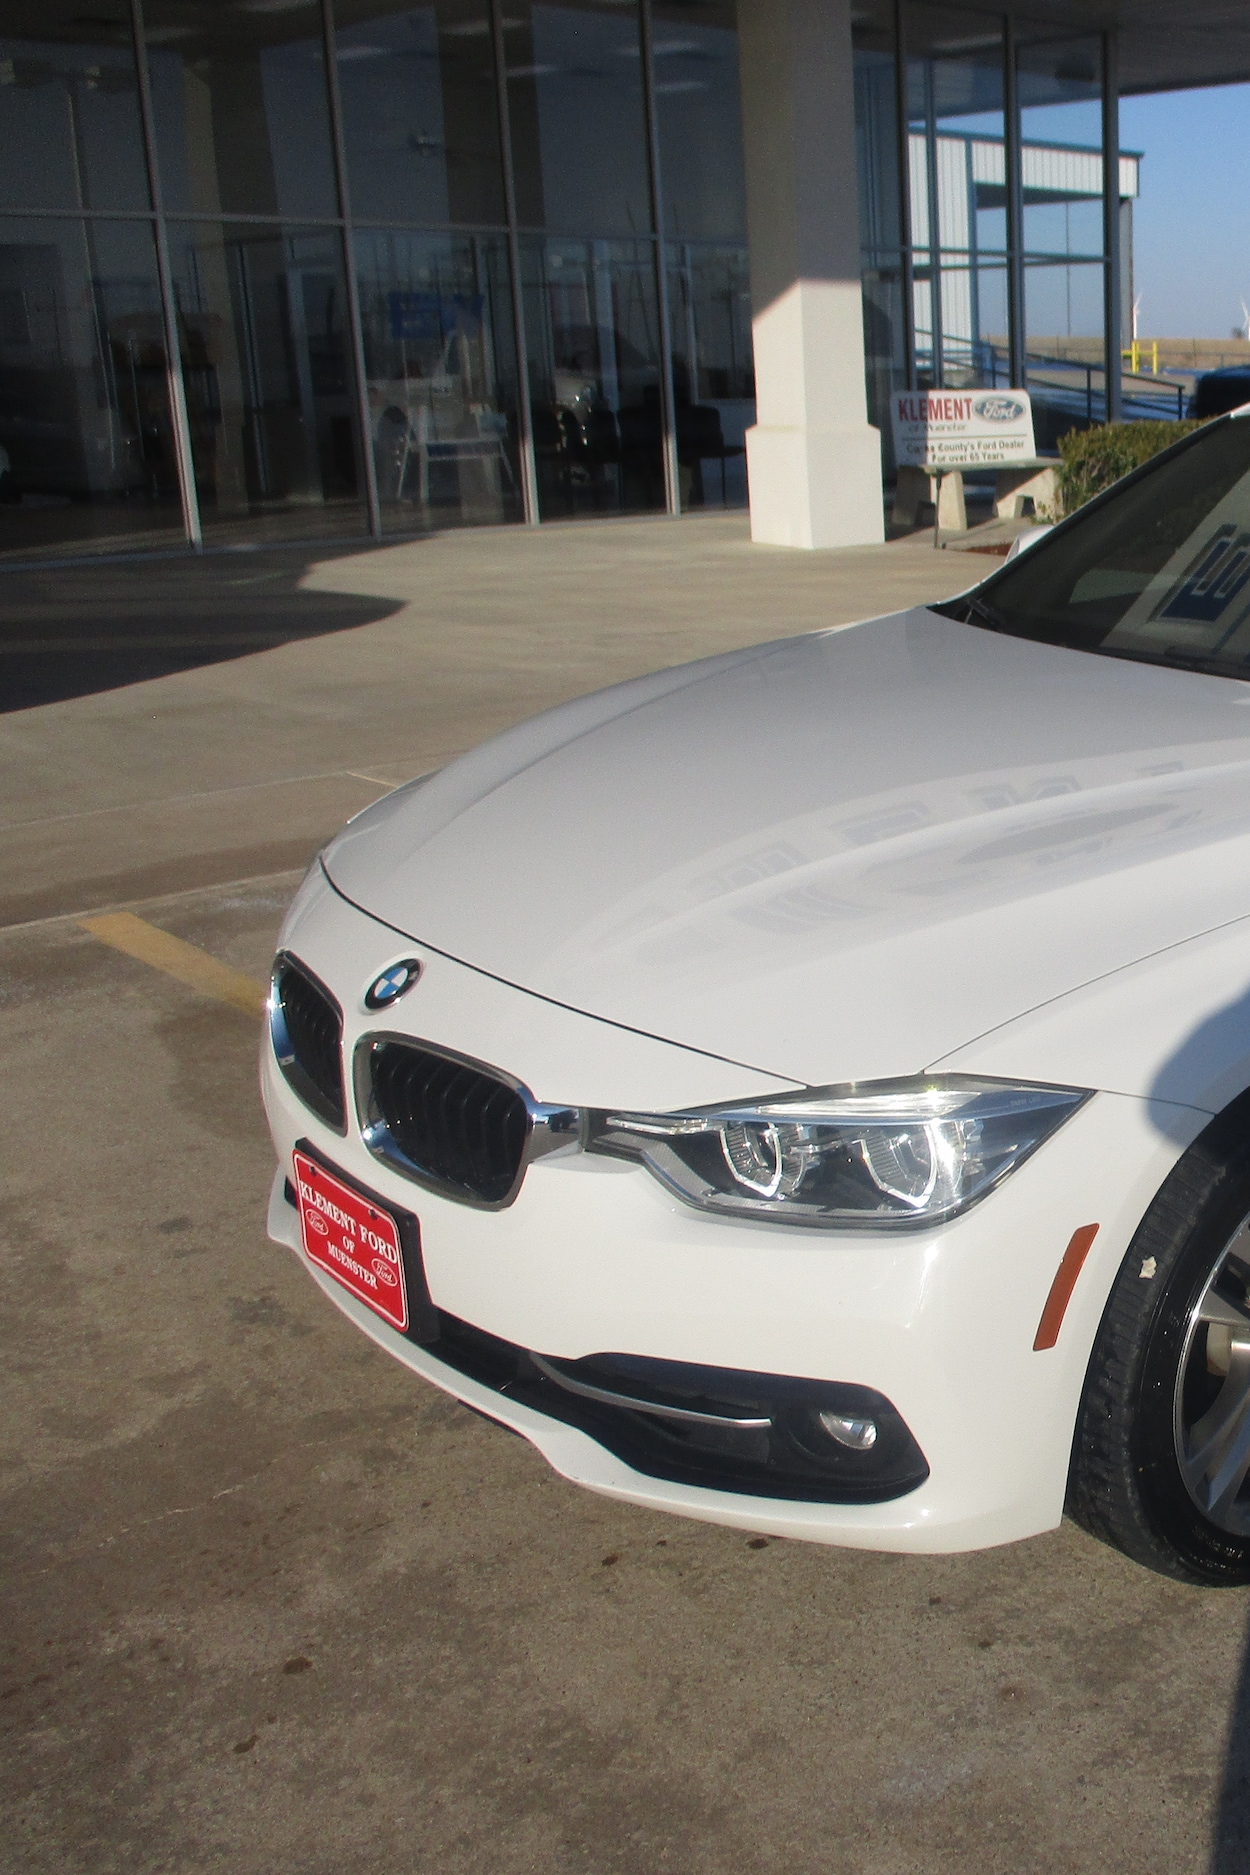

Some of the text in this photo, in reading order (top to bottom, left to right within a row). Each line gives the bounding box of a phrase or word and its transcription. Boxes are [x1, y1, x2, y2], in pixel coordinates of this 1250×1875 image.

[899, 398, 972, 421] KLEMENT
[982, 400, 1016, 419] Ford
[977, 441, 997, 451] Ford
[999, 441, 1025, 449] Dealer
[300, 1179, 398, 1265] KLEMENT FORD
[309, 1213, 325, 1231] Ford
[342, 1235, 356, 1254] OF
[326, 1240, 379, 1290] MUENSTER
[376, 1263, 392, 1283] Ford
